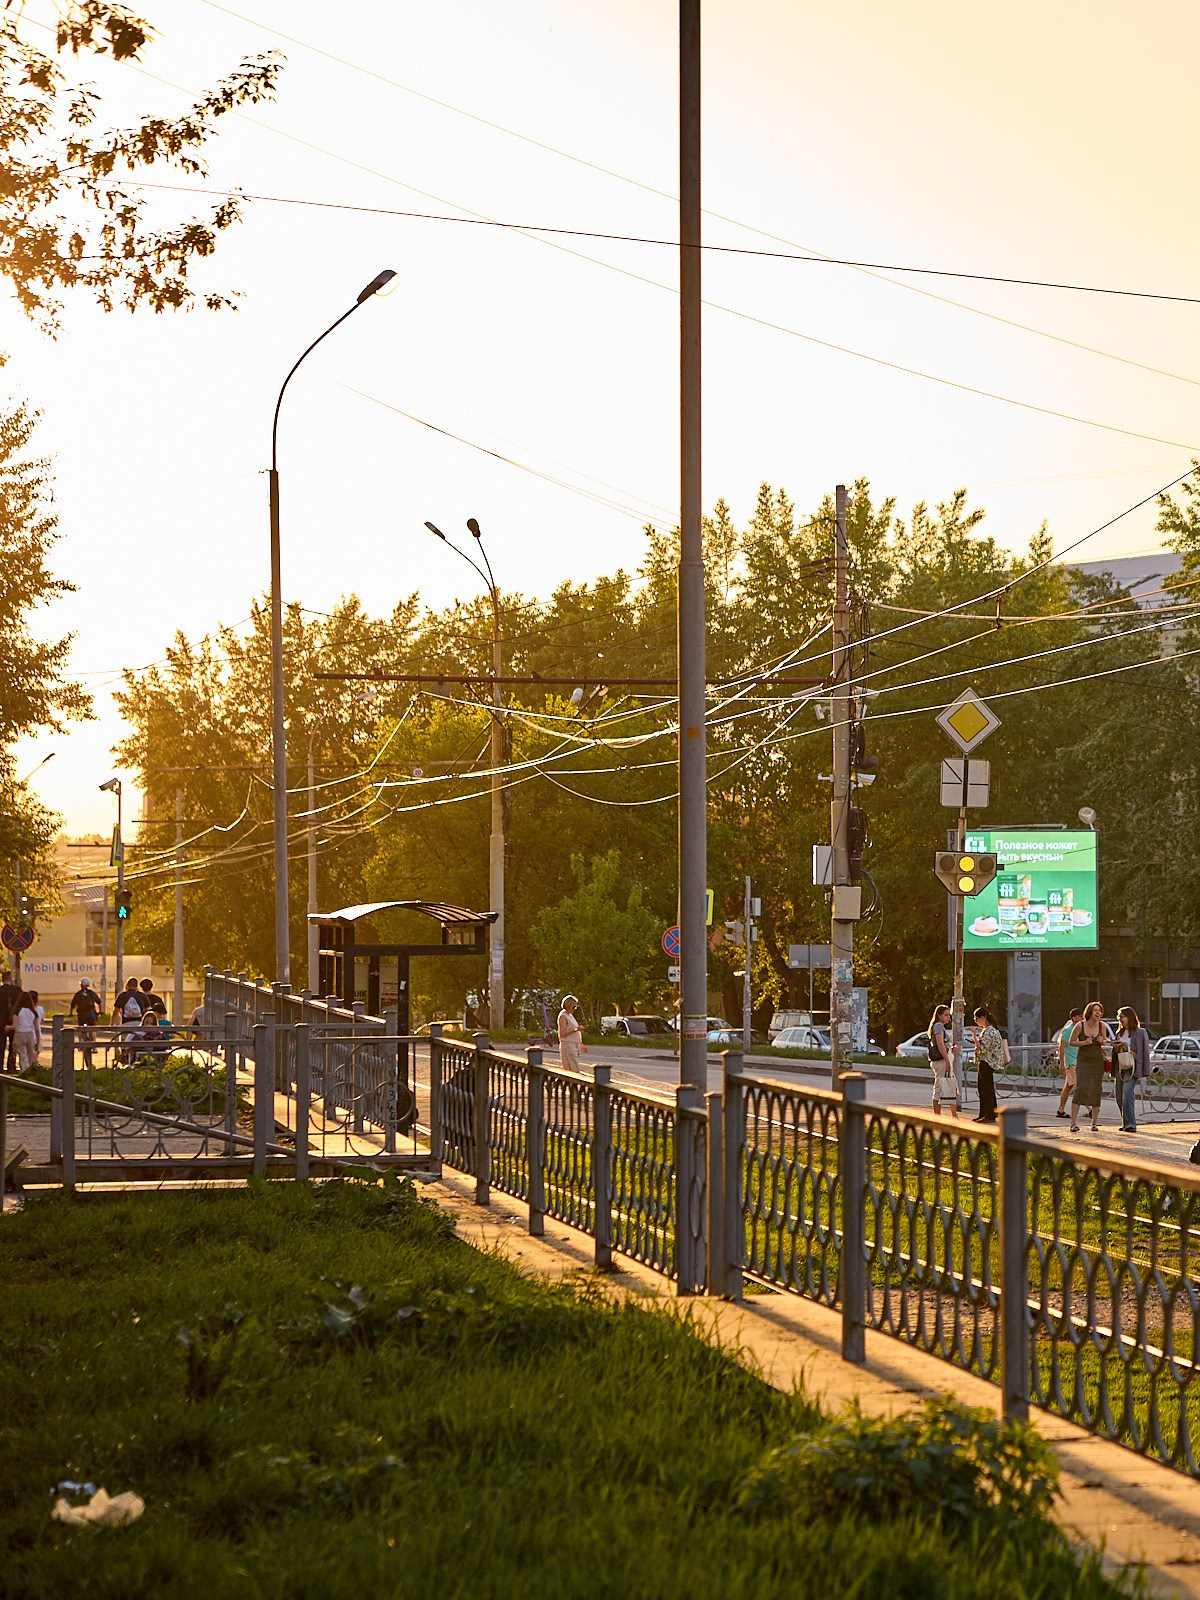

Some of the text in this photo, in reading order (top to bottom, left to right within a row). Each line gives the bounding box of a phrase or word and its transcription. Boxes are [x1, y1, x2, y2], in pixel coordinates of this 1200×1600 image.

[995, 839, 1078, 850] Полезное может
[1020, 853, 1064, 863] вкусным
[999, 882, 1015, 897] fit
[1048, 892, 1063, 905] fit
[24, 962, 55, 973] Mobil
